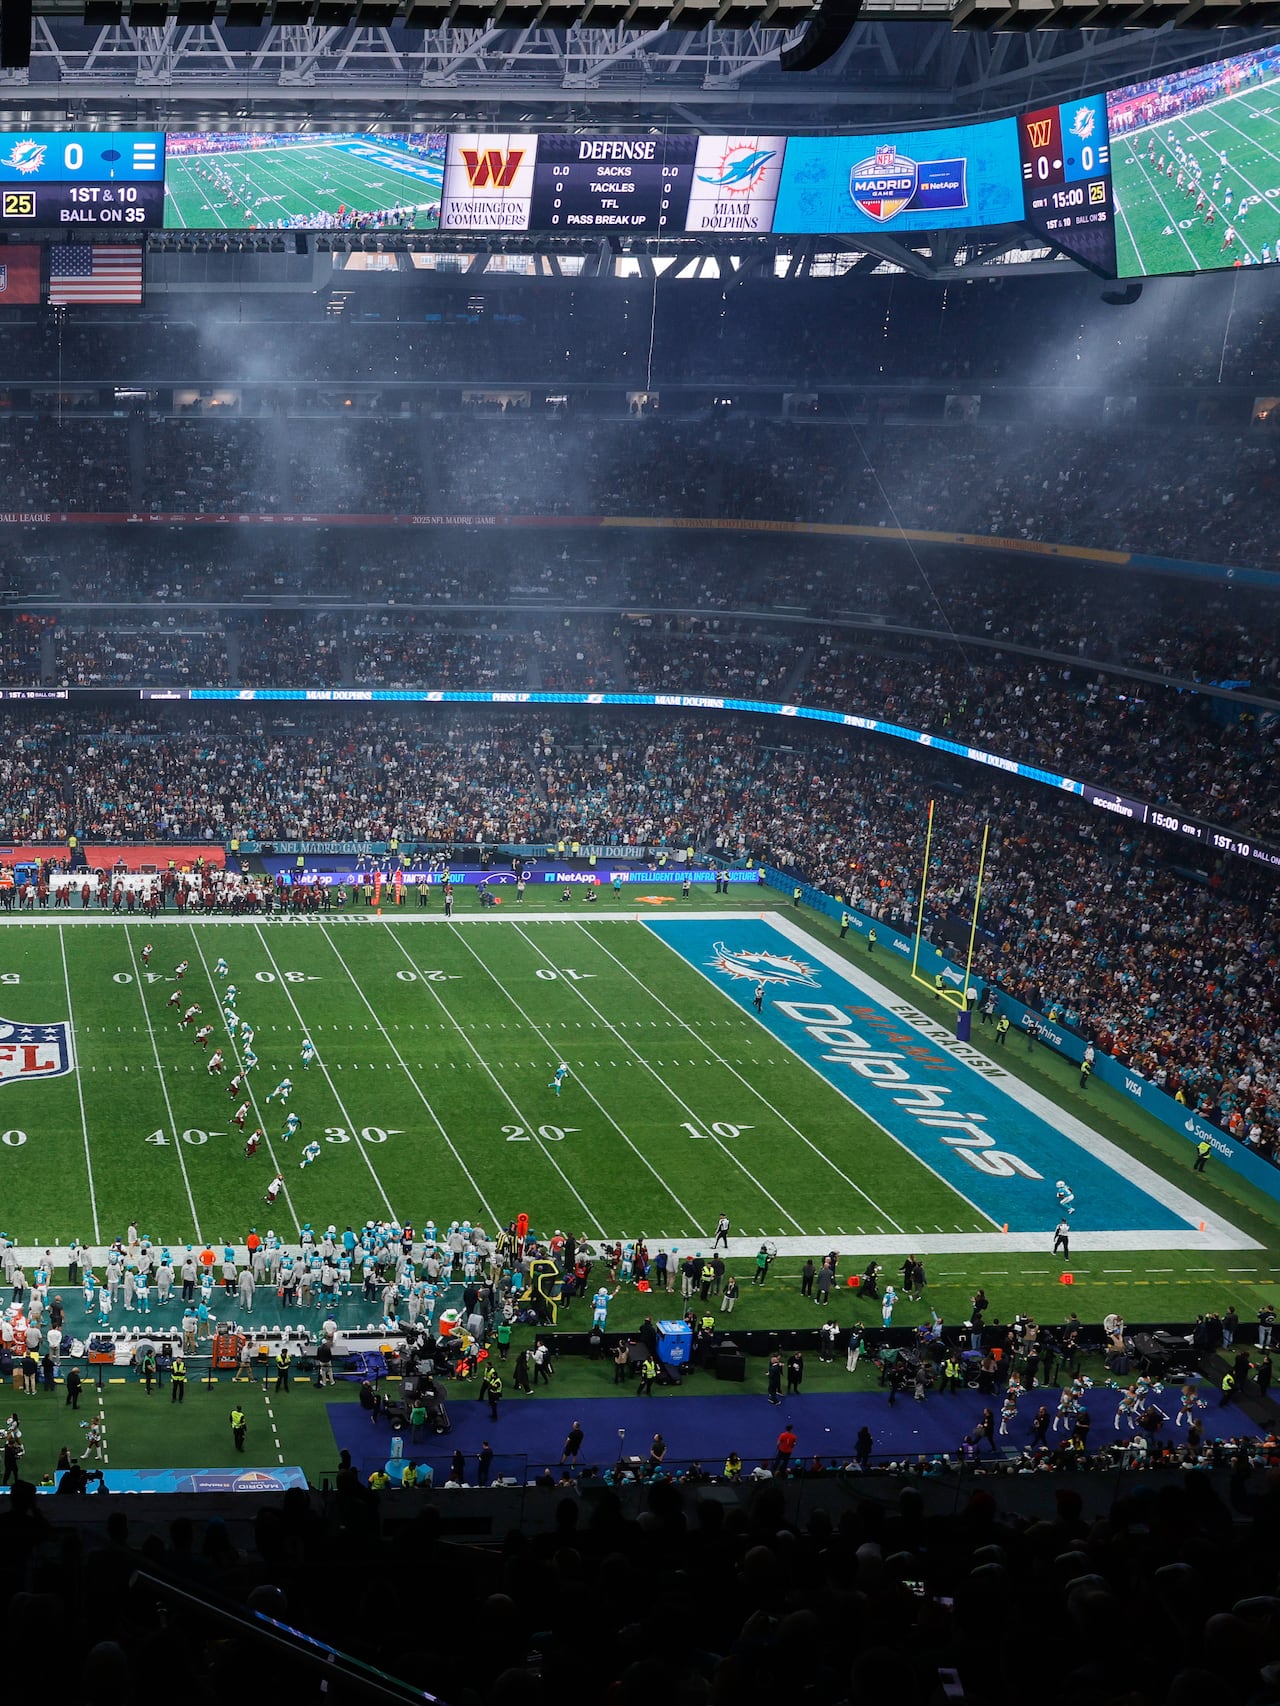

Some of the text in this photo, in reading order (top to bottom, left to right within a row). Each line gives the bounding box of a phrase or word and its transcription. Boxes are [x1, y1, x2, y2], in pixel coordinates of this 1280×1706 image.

[64, 143, 83, 170] 0
[579, 141, 656, 160] DEFENSE
[876, 154, 891, 165] NFL
[1081, 146, 1093, 171] 0
[553, 166, 569, 176] 0.0
[597, 166, 631, 177] SACKS
[662, 167, 678, 177] 0.0
[1038, 156, 1049, 180] 0
[556, 182, 563, 192] 0
[589, 182, 635, 193] TACKLES
[664, 183, 671, 193] 0
[855, 179, 912, 191] MADRID
[930, 182, 959, 190] NetApp
[69, 187, 137, 202] 1ST & 10
[1052, 188, 1083, 209] 15:00
[1090, 185, 1103, 201] 25
[5, 195, 32, 214] 25
[451, 202, 524, 214] WASHINGTON
[554, 199, 561, 209] 0
[600, 199, 619, 209] TFL
[662, 200, 669, 209] 0
[713, 203, 751, 214] MIAMI
[60, 208, 145, 222] BALL ON 35
[446, 214, 526, 226] COMMANDERS
[552, 215, 559, 225] 0
[567, 215, 646, 225] PASS BREAK UP
[660, 215, 667, 225] 0
[1075, 212, 1106, 225] BALL 35
[701, 216, 759, 229] DOLPHINS
[1046, 217, 1071, 230] 1ST 10
[20, 513, 51, 522] LEAGUE
[412, 516, 431, 525] 2025
[431, 516, 445, 525] NFL
[306, 691, 372, 700] MIAMI DOLPHINS
[492, 692, 530, 702] PHINS UP
[655, 695, 724, 708] MIAMI DOLPHINS
[988, 753, 1019, 773] DOLPHINS
[1093, 796, 1133, 817] accenture
[1151, 812, 1179, 831] 15:00
[1182, 824, 1202, 838] QTR 1
[279, 841, 372, 854] NFL MADRID GAME
[1213, 834, 1270, 862] 1ST 10 BALL
[556, 872, 595, 883] NetApp
[630, 872, 673, 881] INTELLIGENT
[674, 872, 693, 881] DATA
[264, 915, 369, 923] MADRID
[844, 1005, 957, 1071] MIAMI
[889, 1005, 1008, 1078] END RACISM
[772, 1000, 1044, 1180] Dolphins
[1125, 1076, 1143, 1098] VISA
[325, 1126, 388, 1143] 30
[500, 1125, 564, 1142] 20
[679, 1121, 739, 1139] 10
[144, 1129, 208, 1146] 40
[1194, 1124, 1235, 1159] Santander
